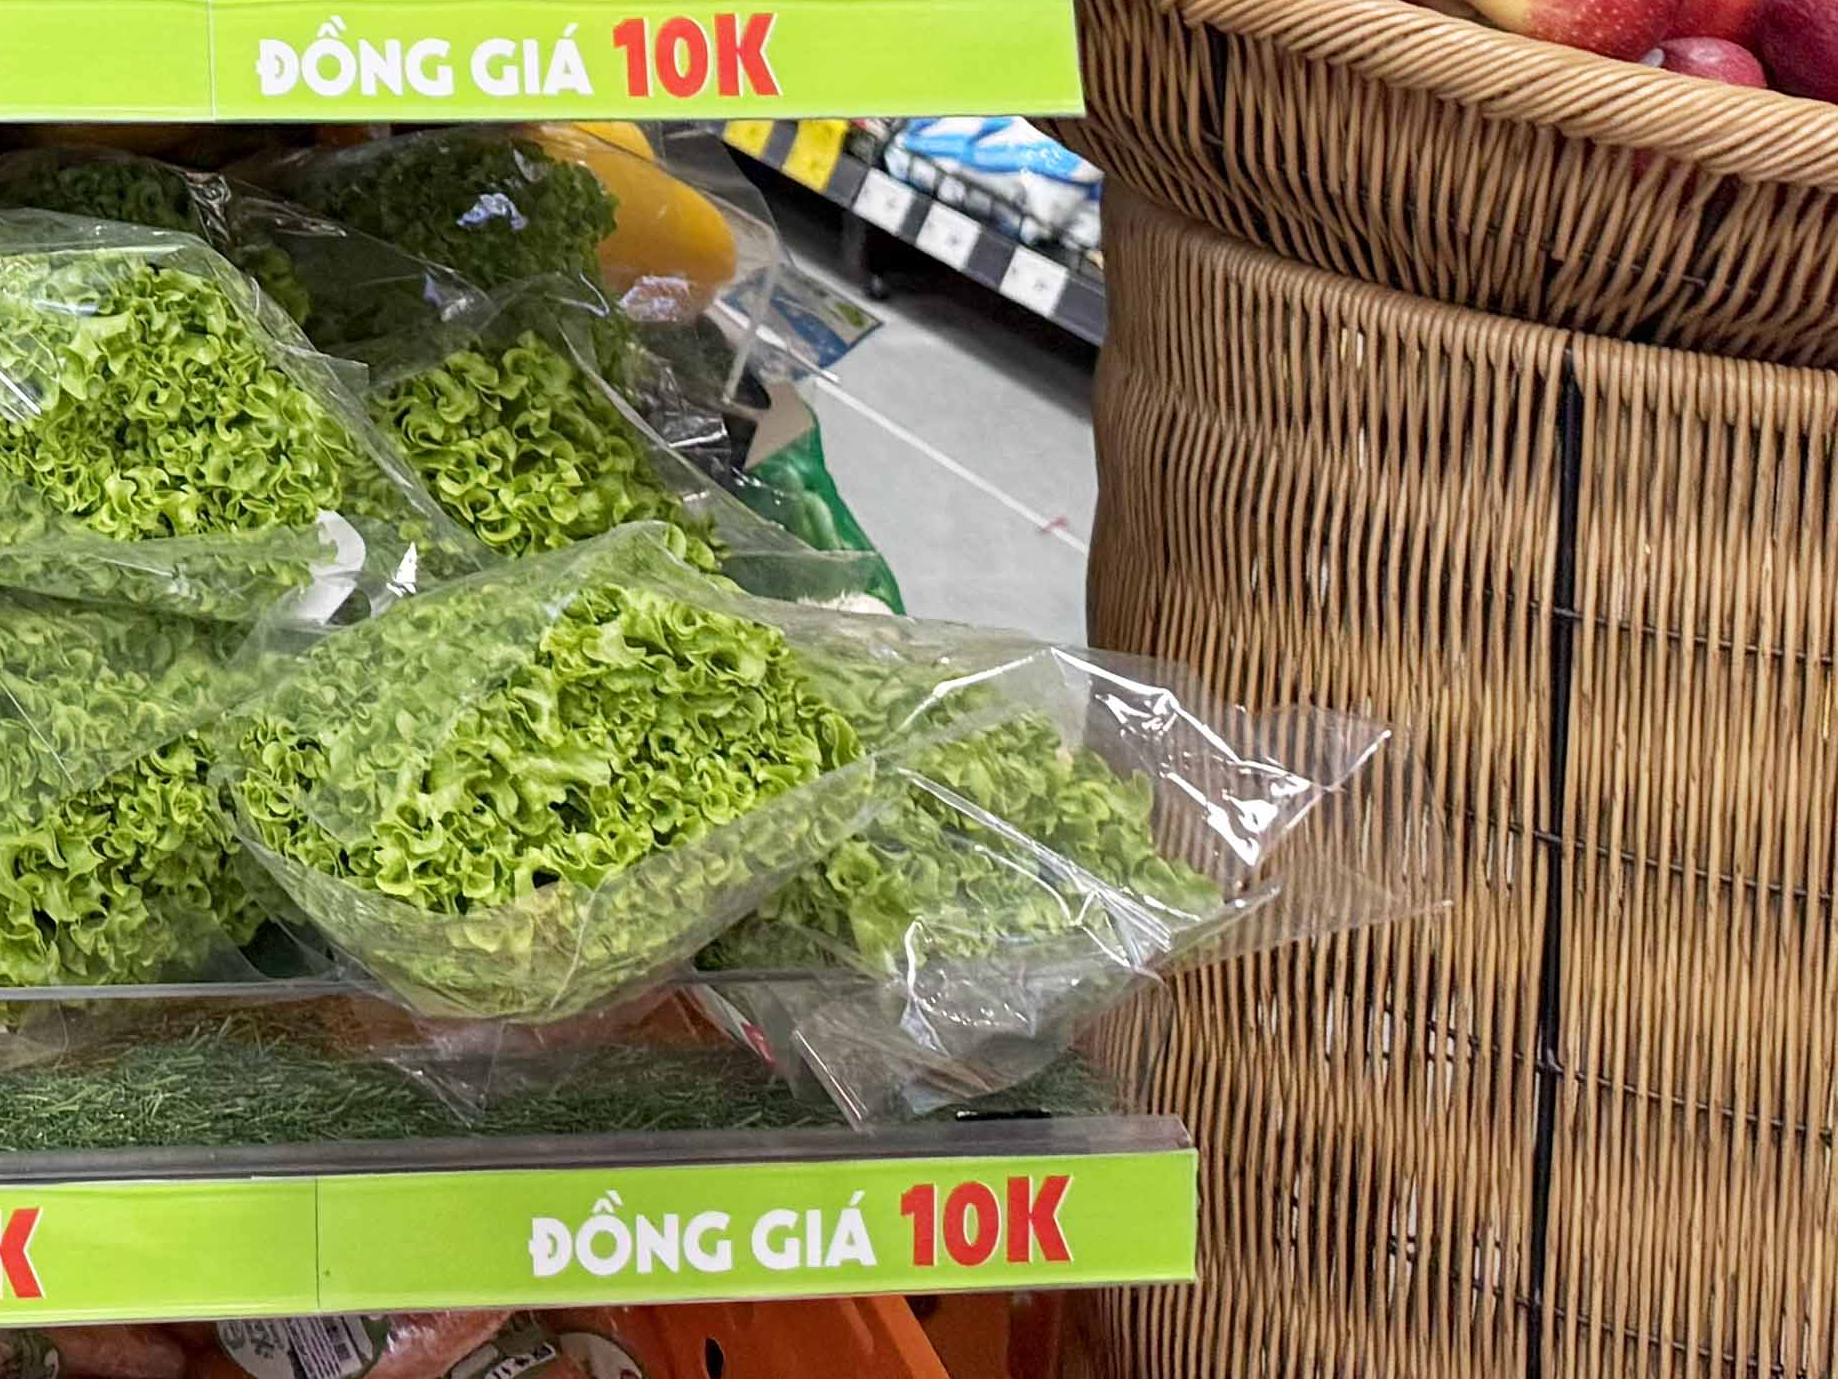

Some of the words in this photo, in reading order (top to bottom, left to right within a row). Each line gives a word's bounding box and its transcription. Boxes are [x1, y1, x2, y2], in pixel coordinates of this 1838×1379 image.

[257, 17, 453, 97] ĐỒNG
[471, 20, 592, 97] GIÁ
[613, 12, 780, 98] 10K
[529, 1192, 732, 1277] ĐỒNG
[752, 1188, 876, 1271] GIÁ
[901, 1175, 1072, 1267] 10K
